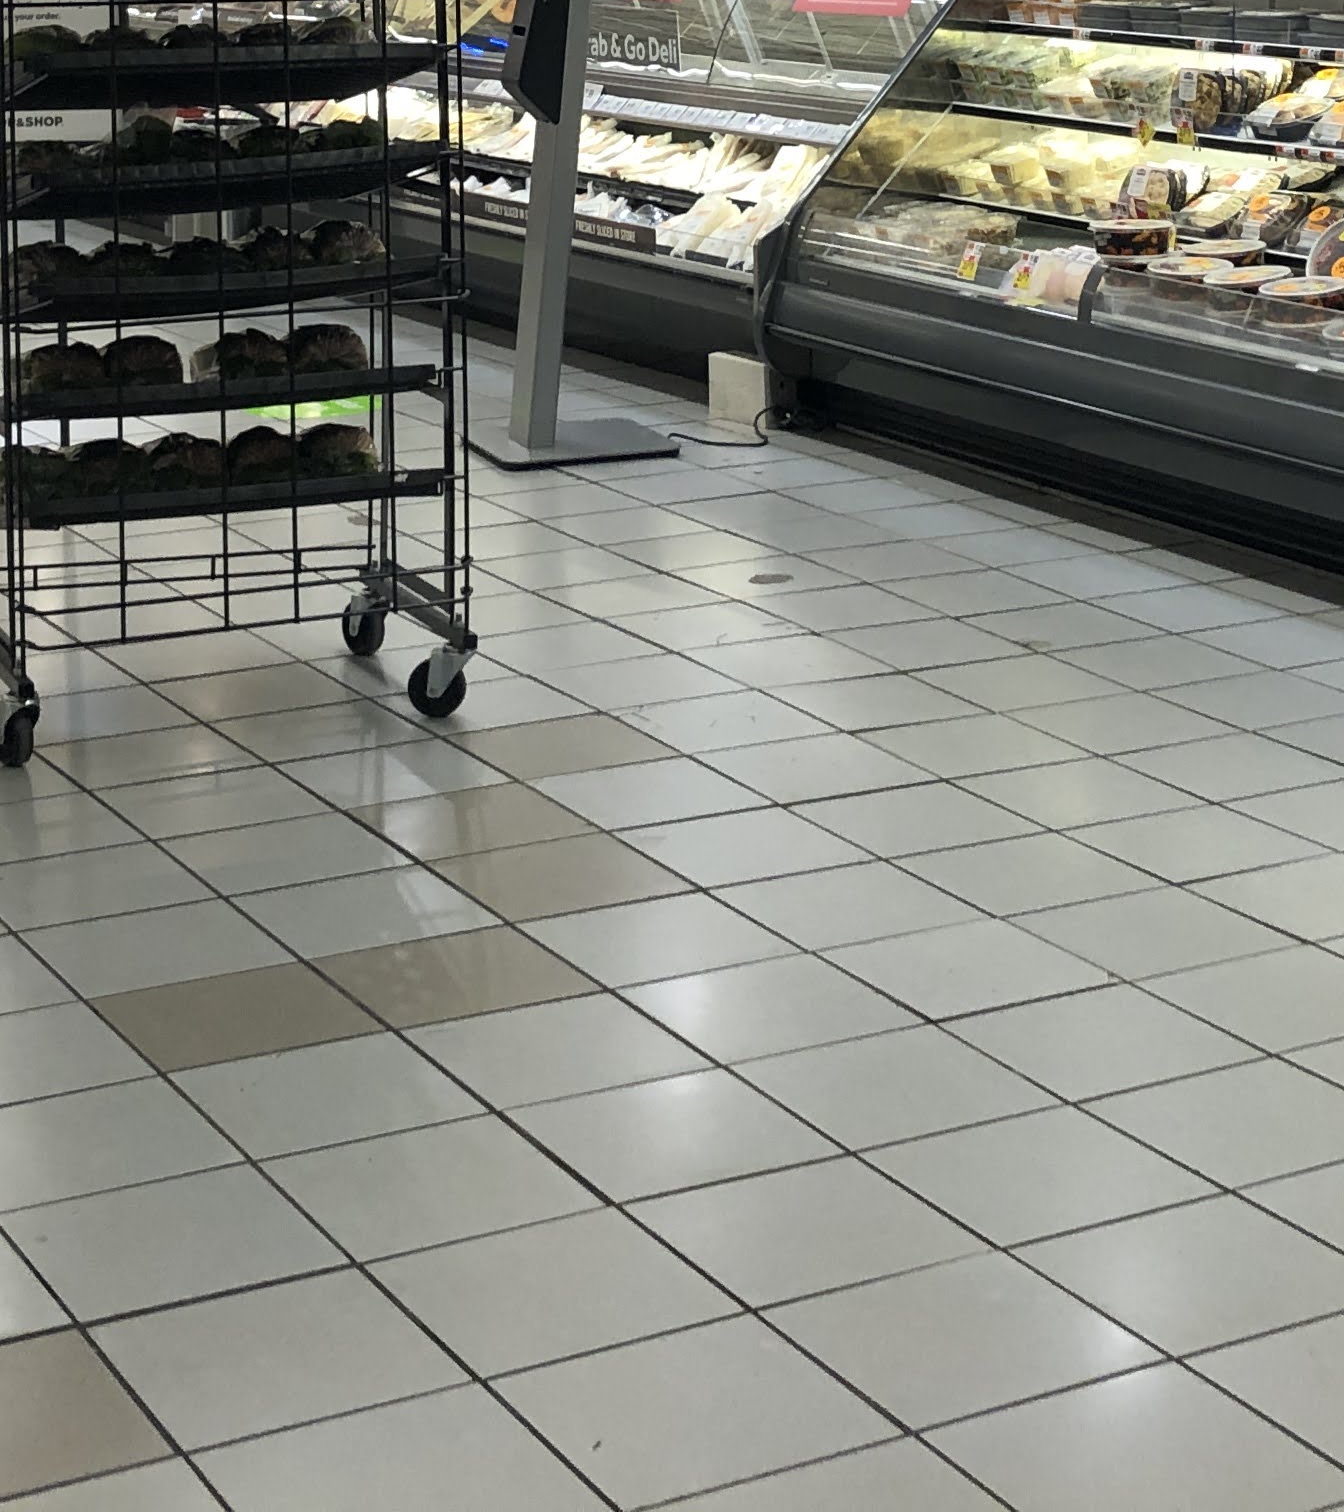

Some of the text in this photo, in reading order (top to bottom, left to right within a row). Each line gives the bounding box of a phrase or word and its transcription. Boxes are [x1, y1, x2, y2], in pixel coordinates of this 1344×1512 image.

[14, 13, 34, 23] your
[611, 32, 622, 57] &
[624, 34, 646, 61] Go
[648, 36, 677, 65] Deli
